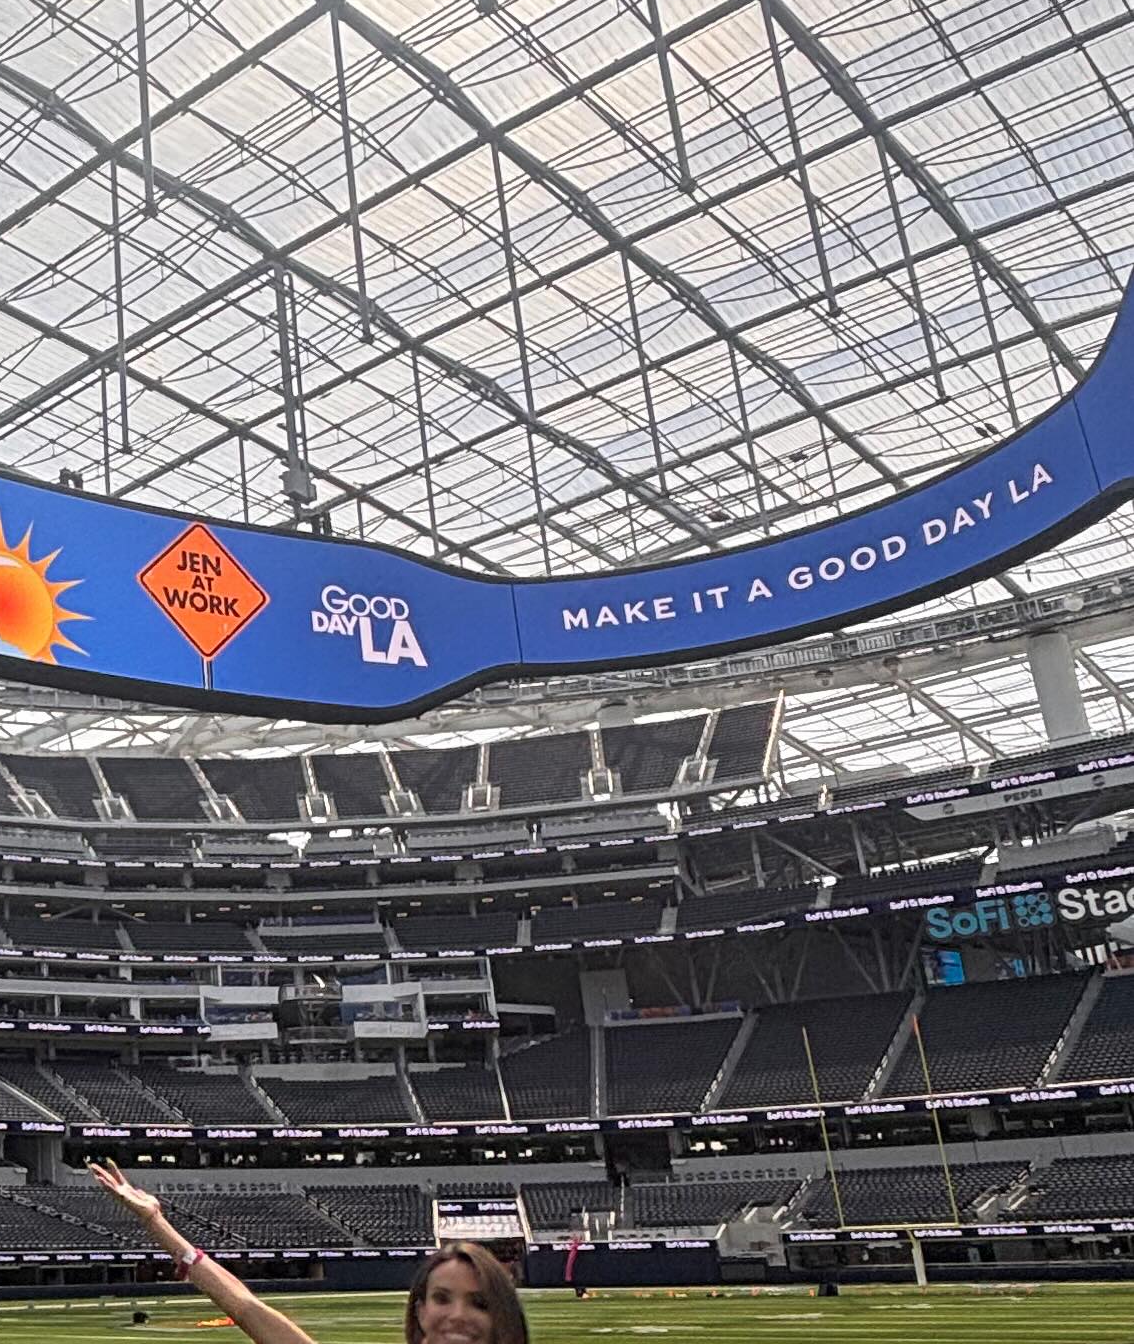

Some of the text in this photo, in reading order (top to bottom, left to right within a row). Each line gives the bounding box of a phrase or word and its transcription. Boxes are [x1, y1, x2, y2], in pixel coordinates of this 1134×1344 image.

[562, 463, 1053, 630] MAKE IT A GOOD DAY LA
[177, 551, 222, 576] JEN
[192, 575, 214, 592] AT
[163, 586, 241, 618] WORK
[321, 585, 409, 620] GOOD
[311, 611, 428, 667] DAY LA
[1003, 788, 1043, 803] PEPSI
[927, 899, 1010, 939] SoFi
